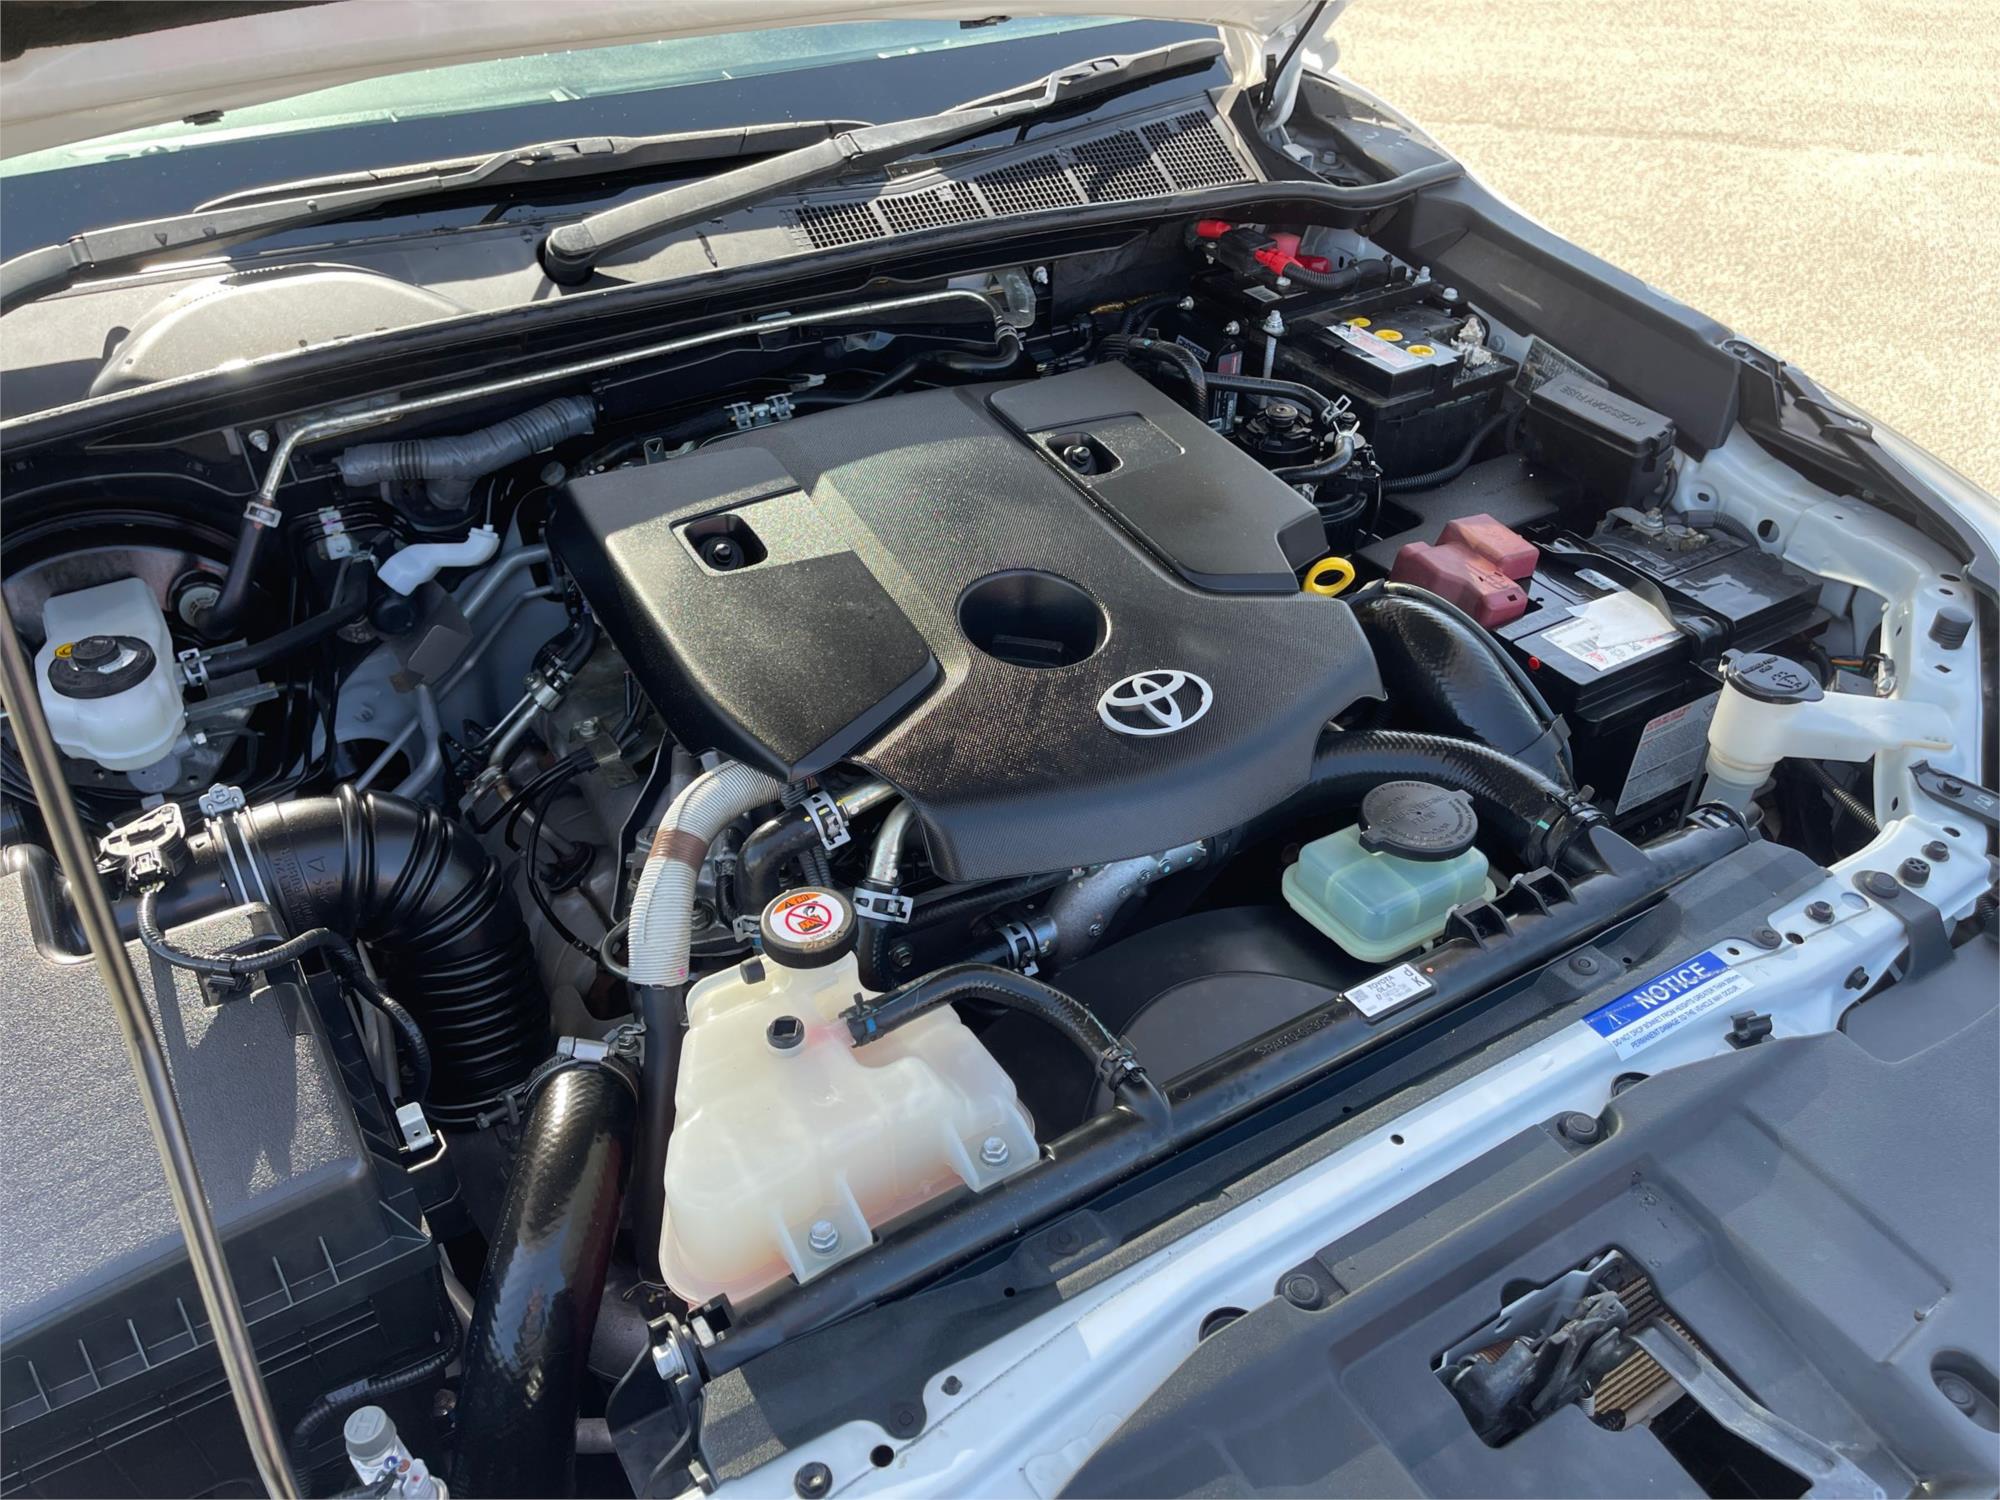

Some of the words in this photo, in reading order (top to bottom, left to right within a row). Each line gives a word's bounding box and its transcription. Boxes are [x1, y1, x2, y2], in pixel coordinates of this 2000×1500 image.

[1559, 385, 1587, 402] FUSE
[1367, 975, 1395, 989] TOYOTA
[1634, 962, 1710, 1009] NOTICE
[1613, 1038, 1622, 1046] DO
[1621, 1033, 1631, 1042] NOT
[1631, 1026, 1643, 1036] DROP
[1643, 1016, 1662, 1029] BONNET
[1662, 1009, 1675, 1019] FROM
[1675, 998, 1694, 1012] HEIGHTS
[1694, 988, 1714, 1001] GREATER
[1714, 982, 1726, 991] THAN
[1631, 1029, 1660, 1049] PERMANENT
[1660, 1019, 1680, 1033] DAMAGE
[1687, 1008, 1696, 1018] THE
[1696, 999, 1713, 1012] VEHICLE
